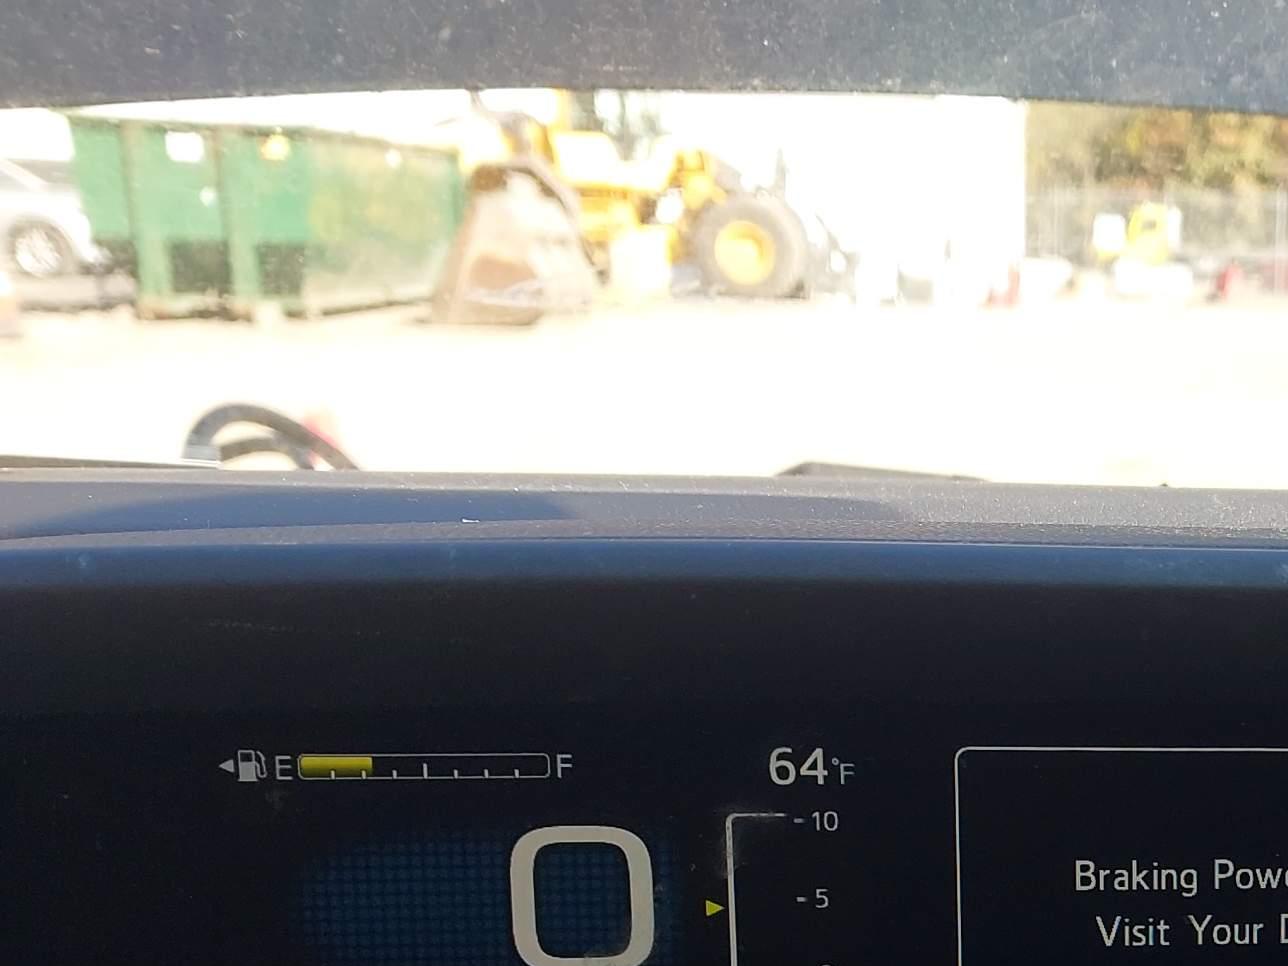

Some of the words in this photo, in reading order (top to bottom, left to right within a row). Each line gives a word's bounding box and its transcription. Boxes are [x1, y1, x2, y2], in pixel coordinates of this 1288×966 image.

[275, 756, 293, 780] E
[557, 754, 572, 778] F
[812, 812, 838, 831] 10
[1076, 860, 1197, 896] Braking
[816, 889, 828, 908] 5
[1096, 916, 1169, 946] Visit
[1188, 915, 1263, 944] Your
